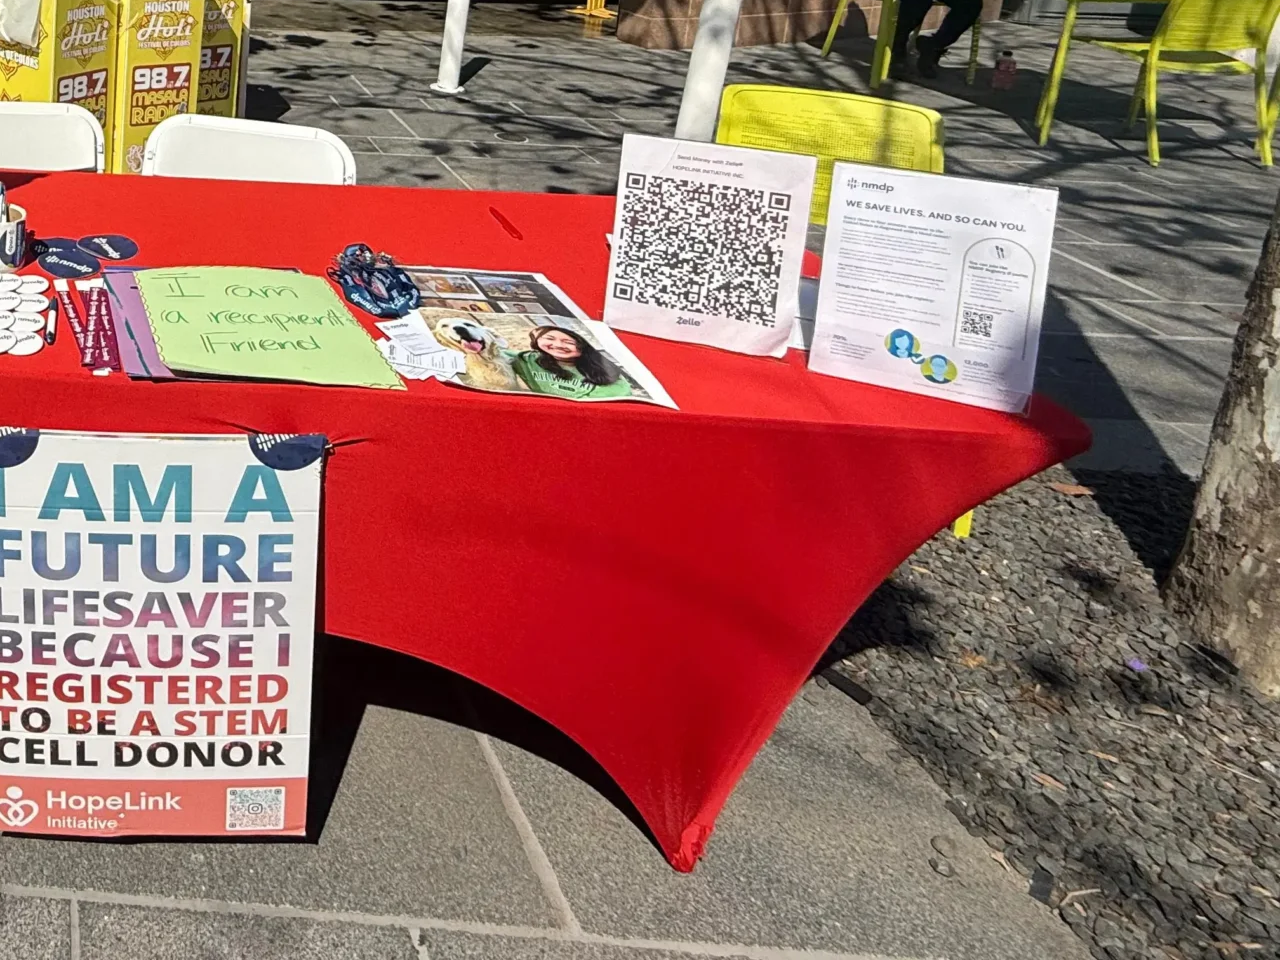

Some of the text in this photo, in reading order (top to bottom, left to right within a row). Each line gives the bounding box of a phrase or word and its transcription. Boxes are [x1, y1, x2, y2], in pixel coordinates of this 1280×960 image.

[67, 5, 105, 22] HOUSTON
[145, 1, 190, 13] HOUSTON
[205, 1, 233, 19] oli
[61, 22, 108, 50] Holi
[137, 14, 193, 41] Holi
[139, 41, 162, 49] FESTIVAL
[14, 52, 39, 69] COLORS
[201, 47, 231, 68] 8.7
[59, 71, 107, 101] 98.7
[134, 66, 190, 90] 98.7
[133, 89, 188, 106] MASALA
[702, 169, 731, 177] INITIATIVE
[861, 180, 894, 194] nmdp
[846, 199, 1026, 233] WE SAVE LIVES. AND SO CAN YOU.
[59, 259, 93, 273] nmdp
[150, 273, 299, 299] I am
[160, 309, 189, 324] a
[676, 315, 701, 328] Zelle
[200, 331, 321, 354] Friend
[38, 463, 192, 523] AM
[224, 464, 293, 523] A
[278, 632, 289, 666] I
[67, 709, 117, 735] BE
[130, 710, 161, 736] A
[174, 709, 288, 736] STEM
[114, 740, 286, 768] DONOR
[46, 789, 181, 814] HopeLink
[46, 815, 118, 831] Initiative
